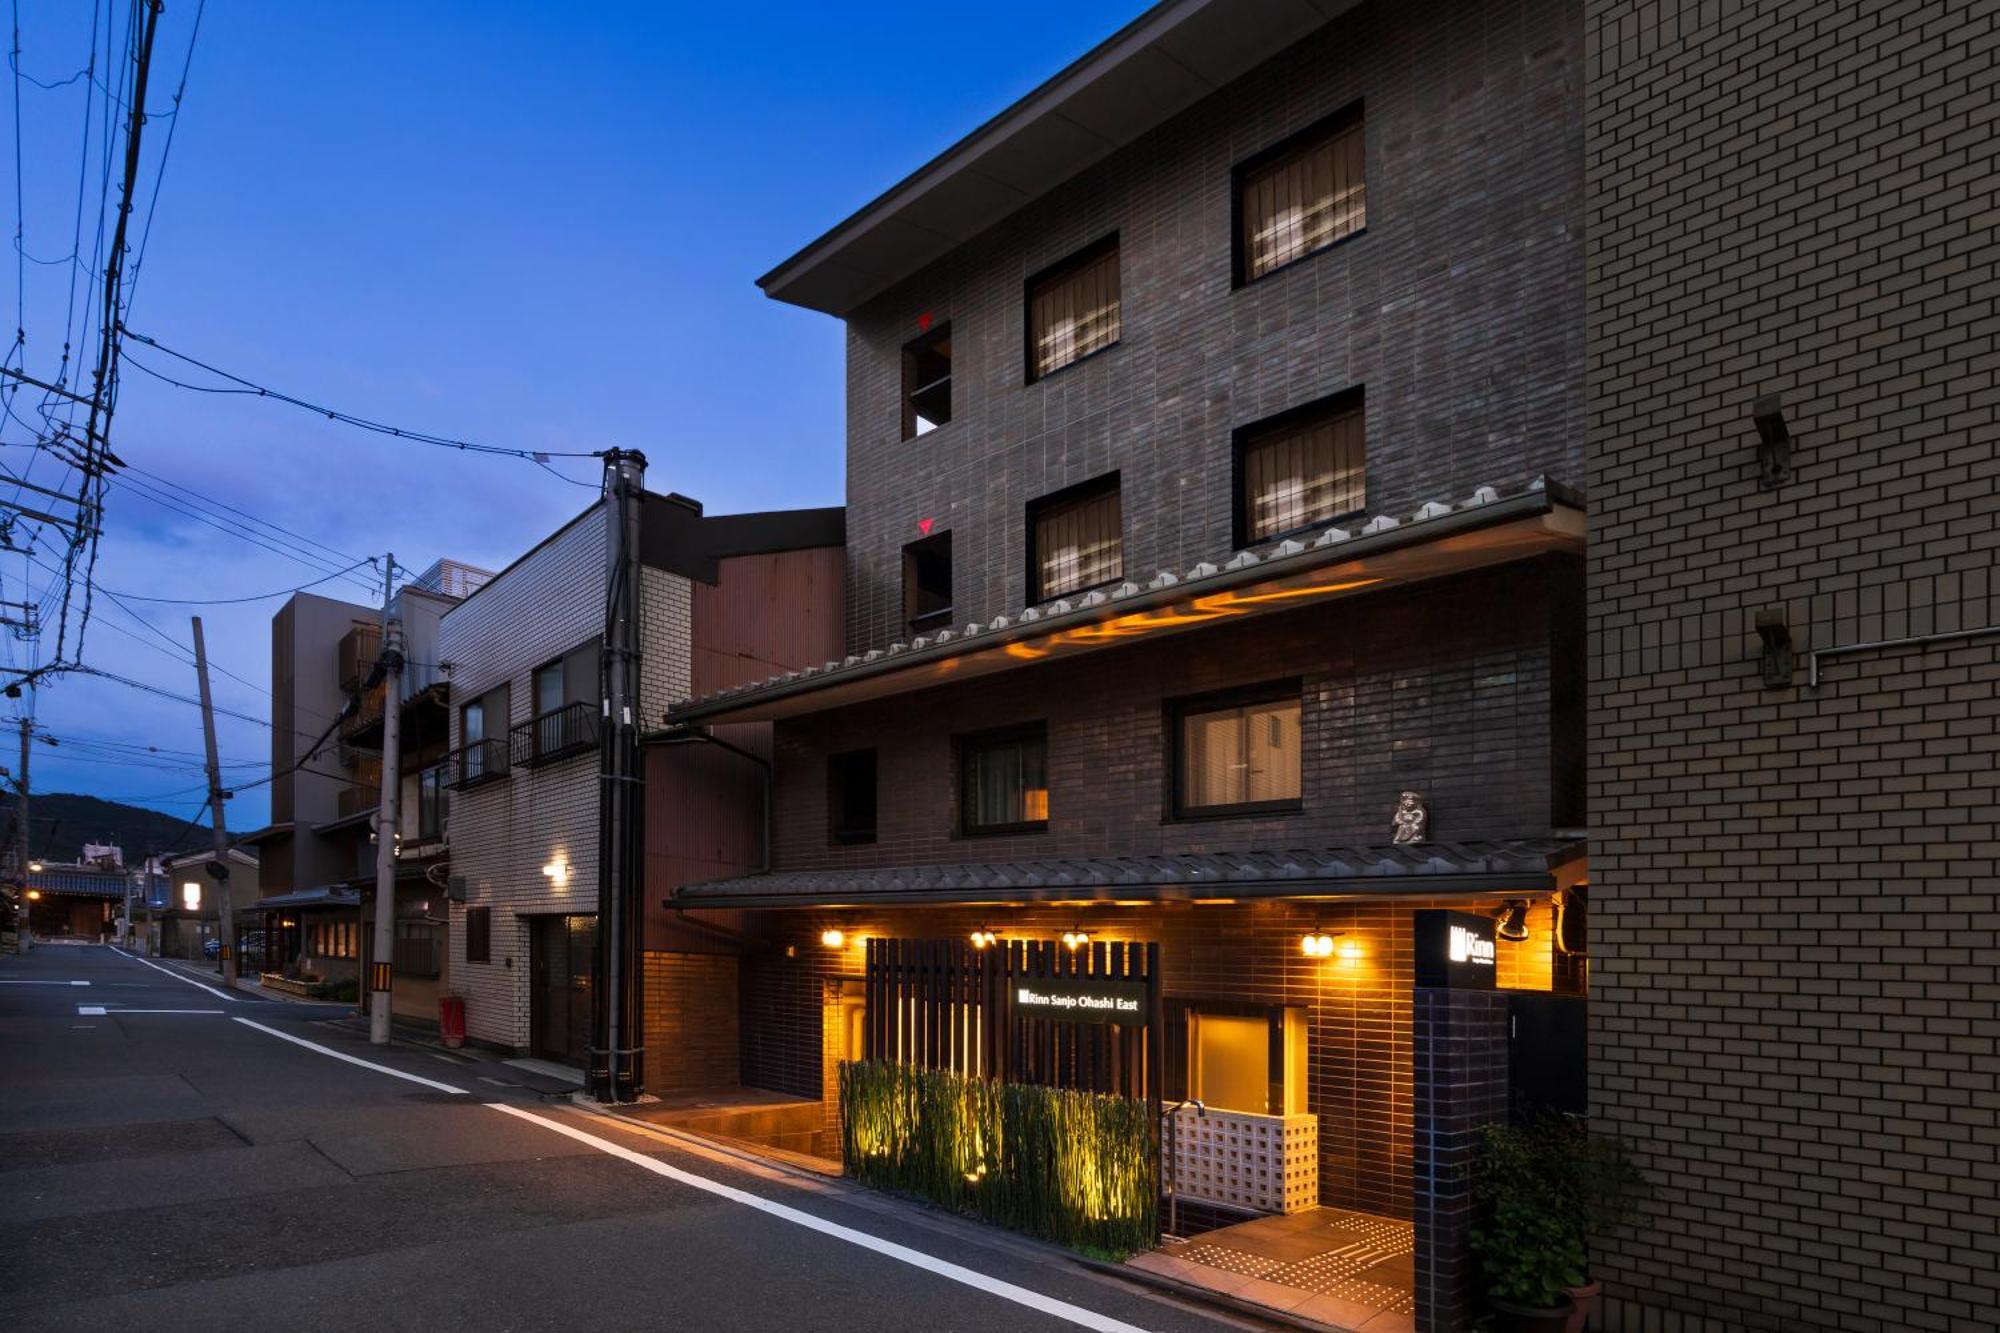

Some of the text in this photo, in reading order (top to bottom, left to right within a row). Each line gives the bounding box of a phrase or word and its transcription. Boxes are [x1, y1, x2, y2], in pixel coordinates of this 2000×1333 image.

[1466, 932, 1494, 958] Rinn
[1029, 993, 1138, 1011] Rinn Sanjo Ohashi East
